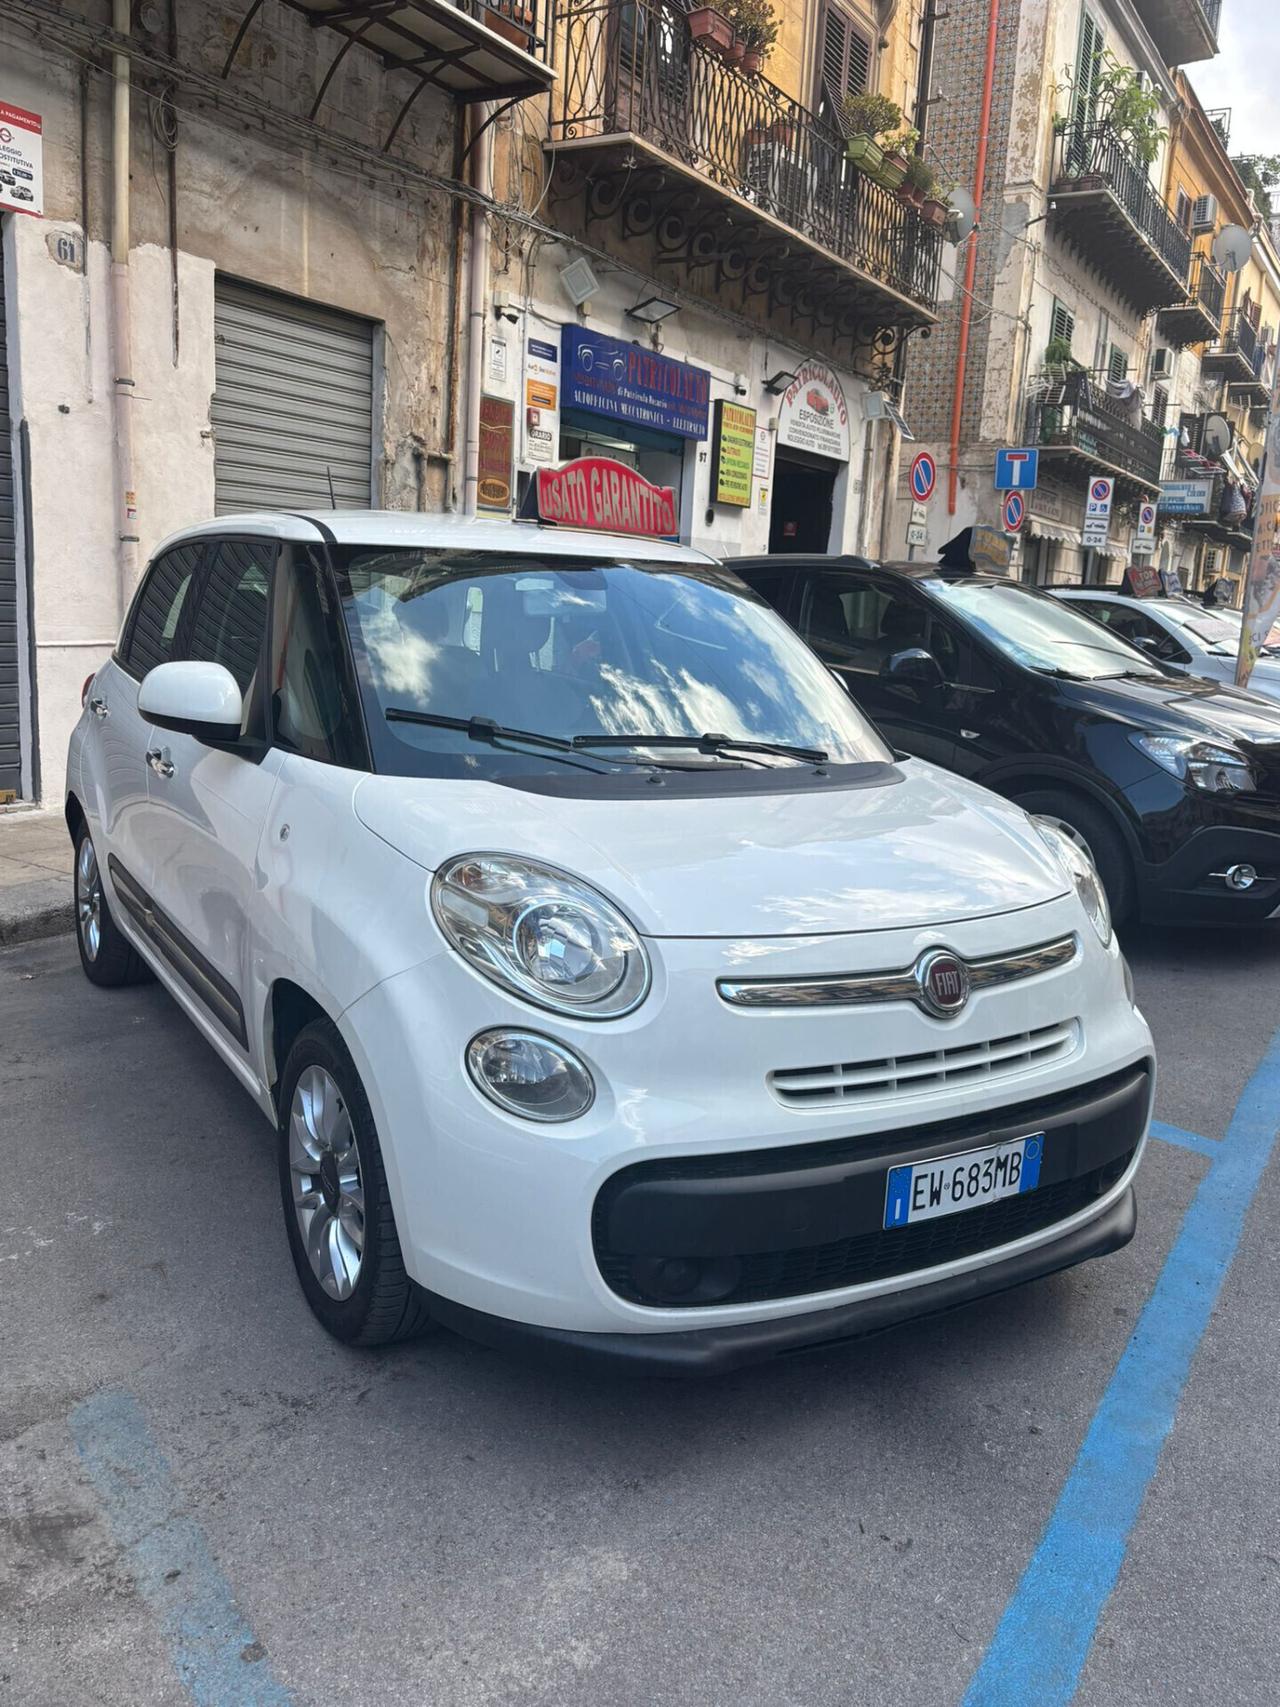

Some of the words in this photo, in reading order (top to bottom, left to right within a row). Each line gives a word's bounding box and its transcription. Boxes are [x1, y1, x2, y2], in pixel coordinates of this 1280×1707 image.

[57, 238, 75, 263] 61
[786, 365, 846, 426] PATRICOLAUTO
[799, 409, 834, 430] ESPOSIZIONE
[542, 468, 588, 522] USATO
[590, 467, 673, 532] GARANTITO
[935, 970, 960, 996] FIAT
[911, 1170, 944, 1212] EW
[951, 1150, 1022, 1202] 683MB
